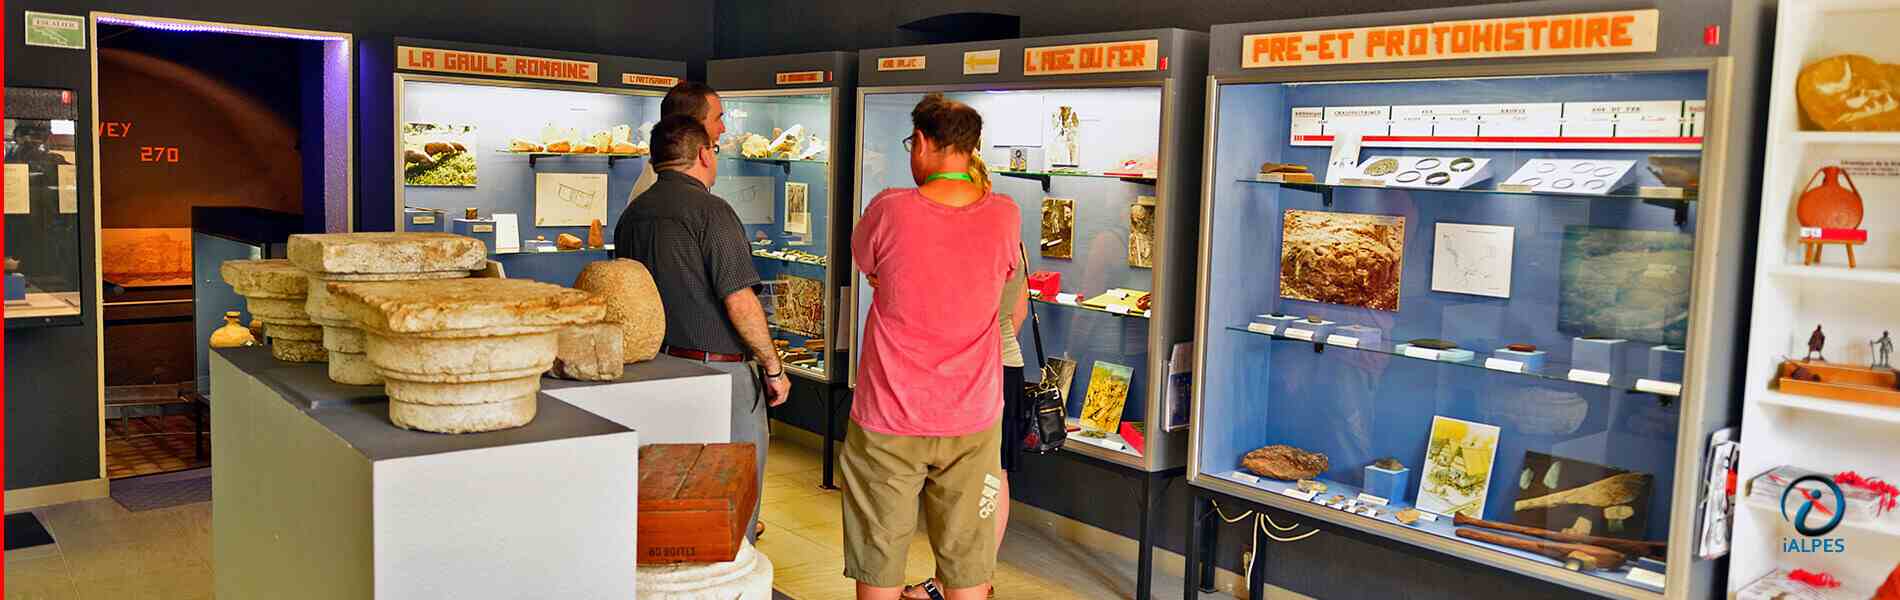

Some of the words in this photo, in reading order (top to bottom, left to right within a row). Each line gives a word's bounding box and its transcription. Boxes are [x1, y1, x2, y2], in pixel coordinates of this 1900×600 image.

[1364, 15, 1635, 59] PROTOHISTOIRE
[408, 49, 435, 68] LA
[443, 53, 508, 74] GAULE
[514, 58, 590, 79] ROMAINE
[1079, 47, 1103, 69] DU
[1107, 44, 1146, 67] FER
[140, 146, 179, 162] 270
